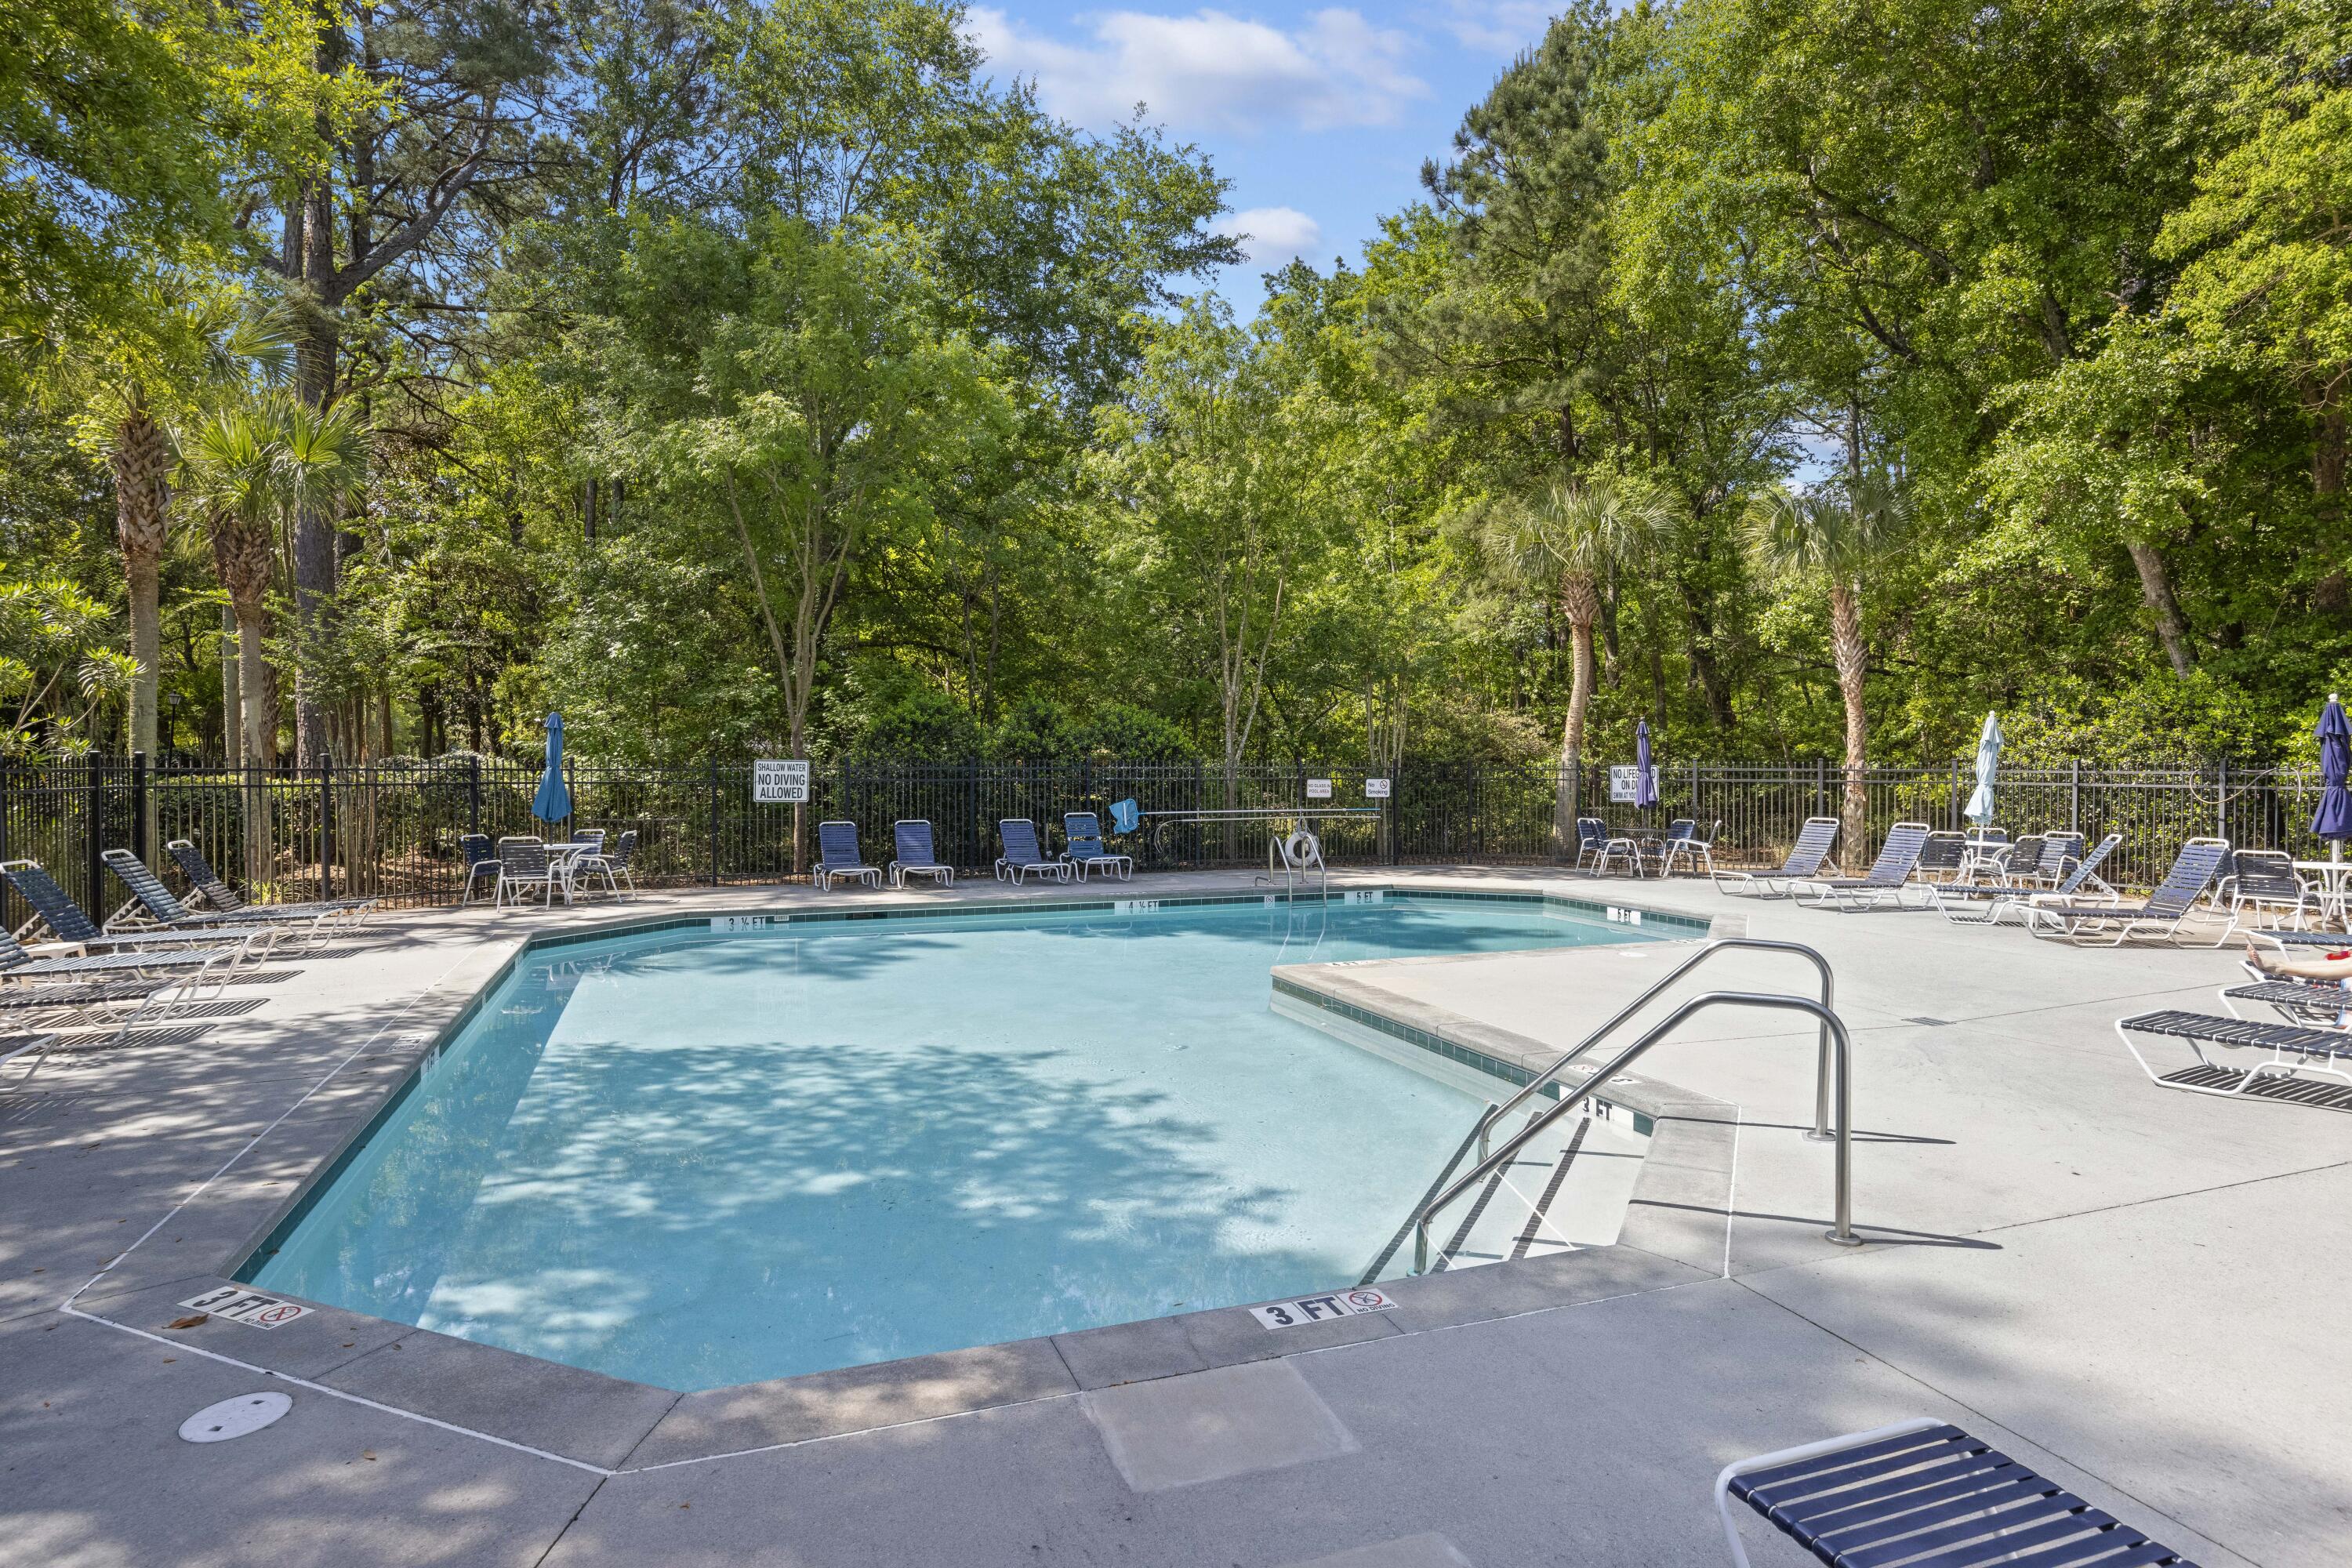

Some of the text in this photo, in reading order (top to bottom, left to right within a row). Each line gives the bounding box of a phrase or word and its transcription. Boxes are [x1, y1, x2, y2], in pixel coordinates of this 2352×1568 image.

[757, 763, 786, 771] SHALLOW
[758, 773, 805, 786] NO DIVING
[1613, 768, 1656, 779] NO LIFEGD
[1621, 780, 1630, 789] ON
[760, 786, 803, 798] ALLOWED
[1582, 1096, 1613, 1121] 3 FT
[192, 1290, 281, 1318] 3 FT
[1265, 1296, 1345, 1325] 3 FT
